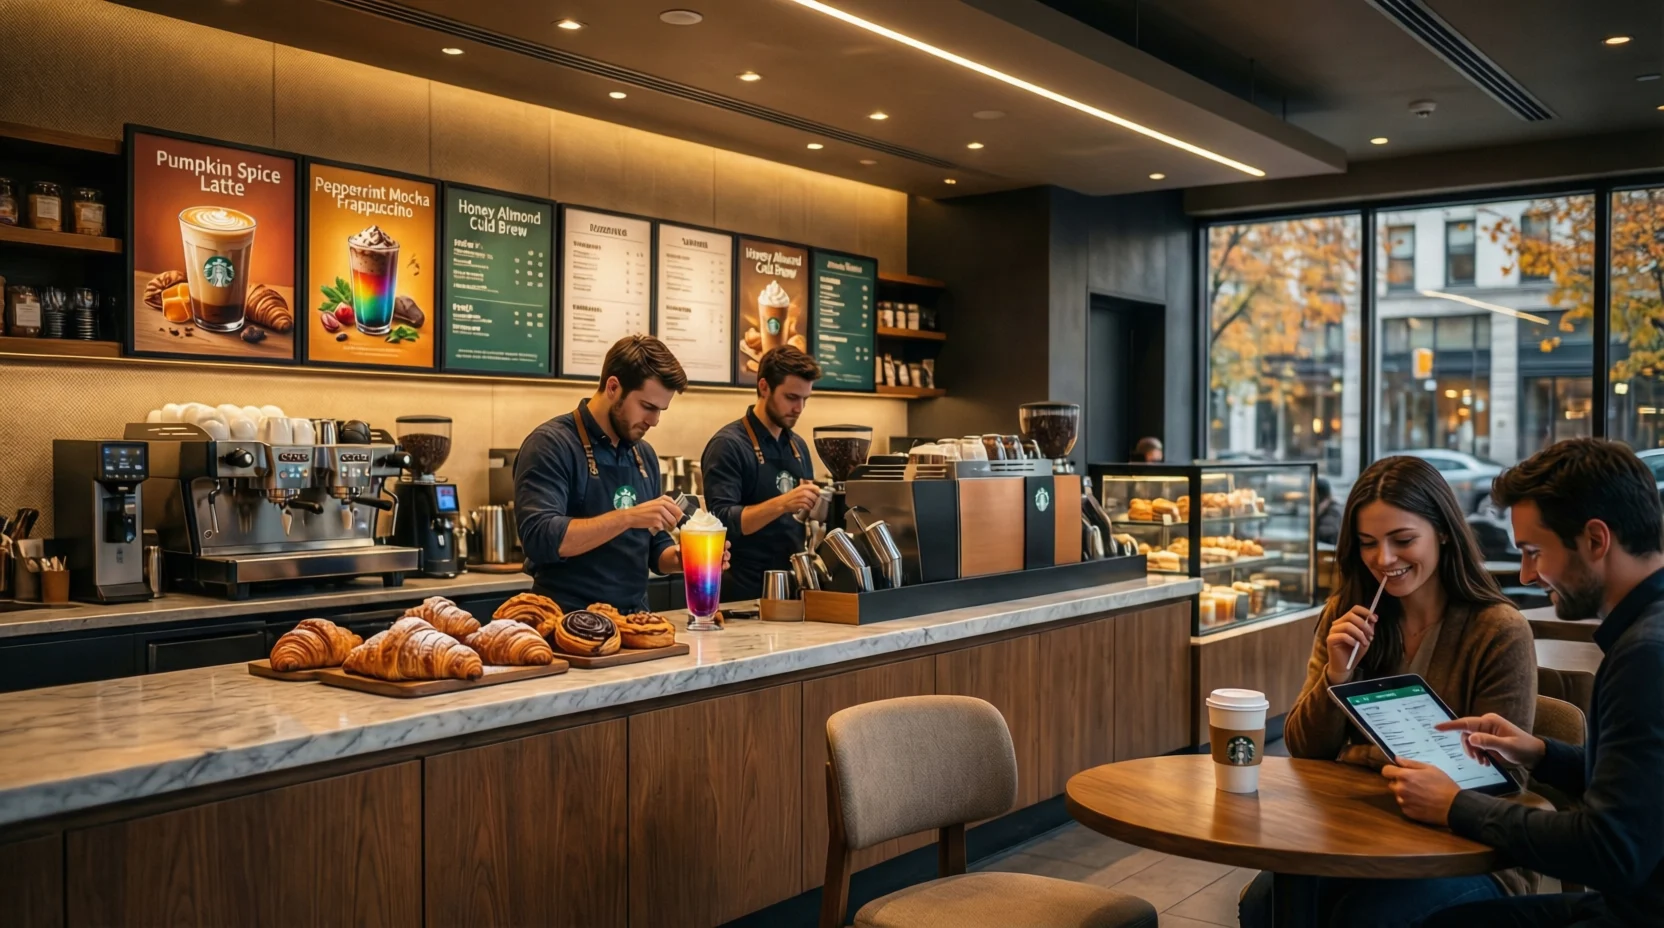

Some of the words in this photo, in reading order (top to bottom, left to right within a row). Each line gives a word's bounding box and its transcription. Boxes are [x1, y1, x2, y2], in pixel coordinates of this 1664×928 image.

[156, 150, 232, 177] Pumpkin
[237, 162, 281, 184] Spice
[200, 174, 245, 197] Latte
[389, 187, 430, 207] Mocha
[458, 198, 495, 220] Honey
[497, 206, 541, 225] Almond
[498, 220, 528, 238] Brew
